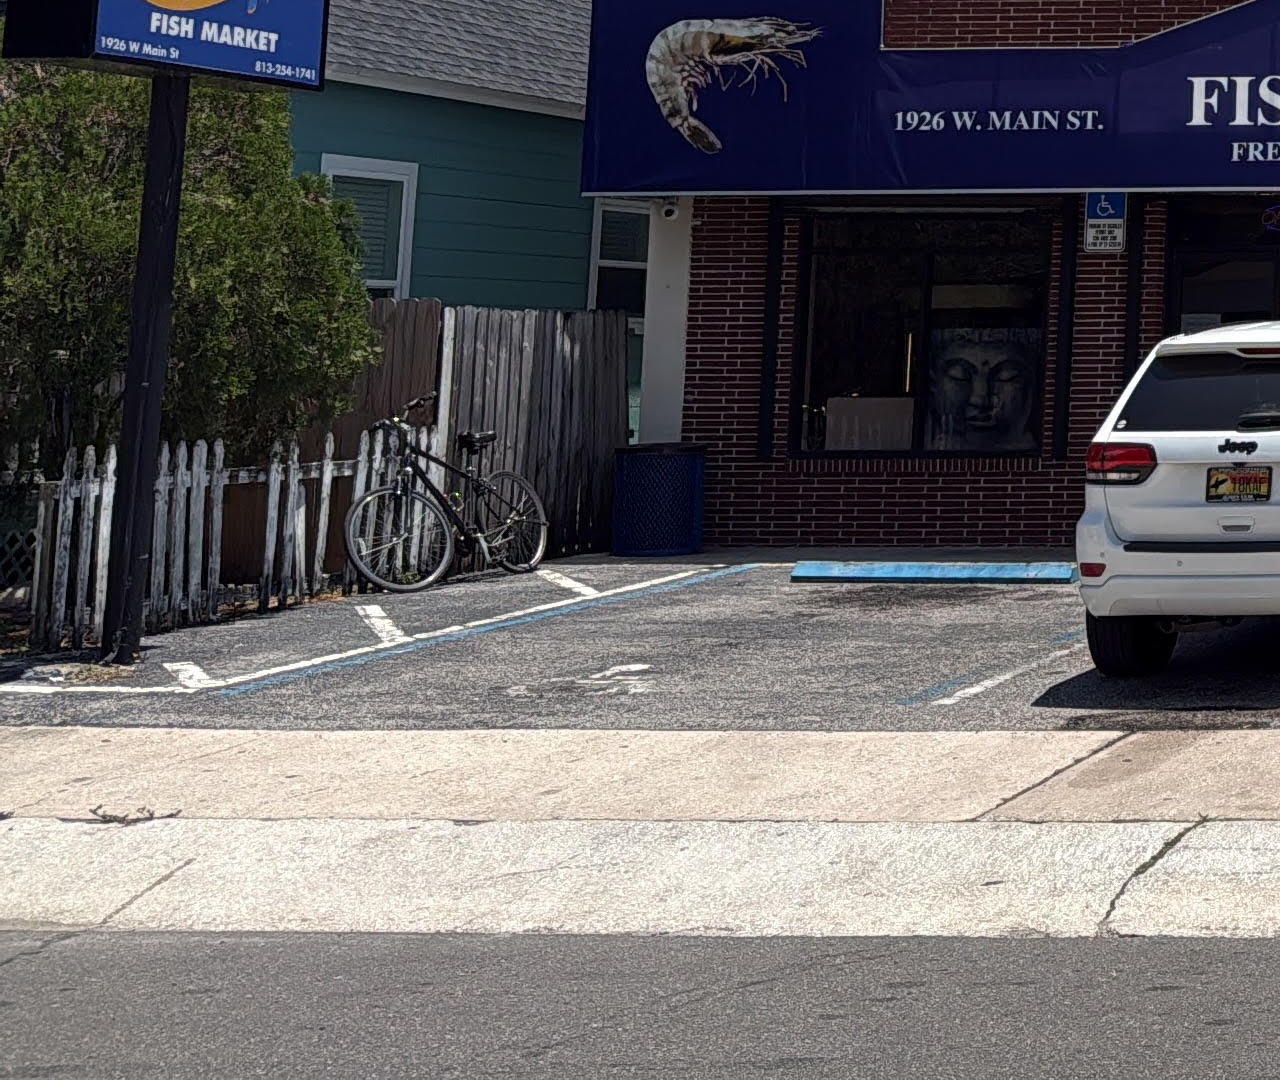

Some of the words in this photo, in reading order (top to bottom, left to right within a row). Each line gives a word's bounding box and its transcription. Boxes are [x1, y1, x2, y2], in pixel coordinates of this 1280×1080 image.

[150, 12, 194, 39] FISH
[201, 21, 279, 53] MARKET
[101, 36, 126, 52] 1926
[128, 40, 141, 53] W
[142, 43, 167, 58] Main
[169, 47, 180, 59] St
[255, 61, 315, 81] 813-254-1741
[895, 111, 945, 131] 1926
[951, 111, 982, 131] W.
[987, 110, 1060, 130] MAIN
[1066, 109, 1104, 130] ST.
[1218, 438, 1258, 455] Jeep
